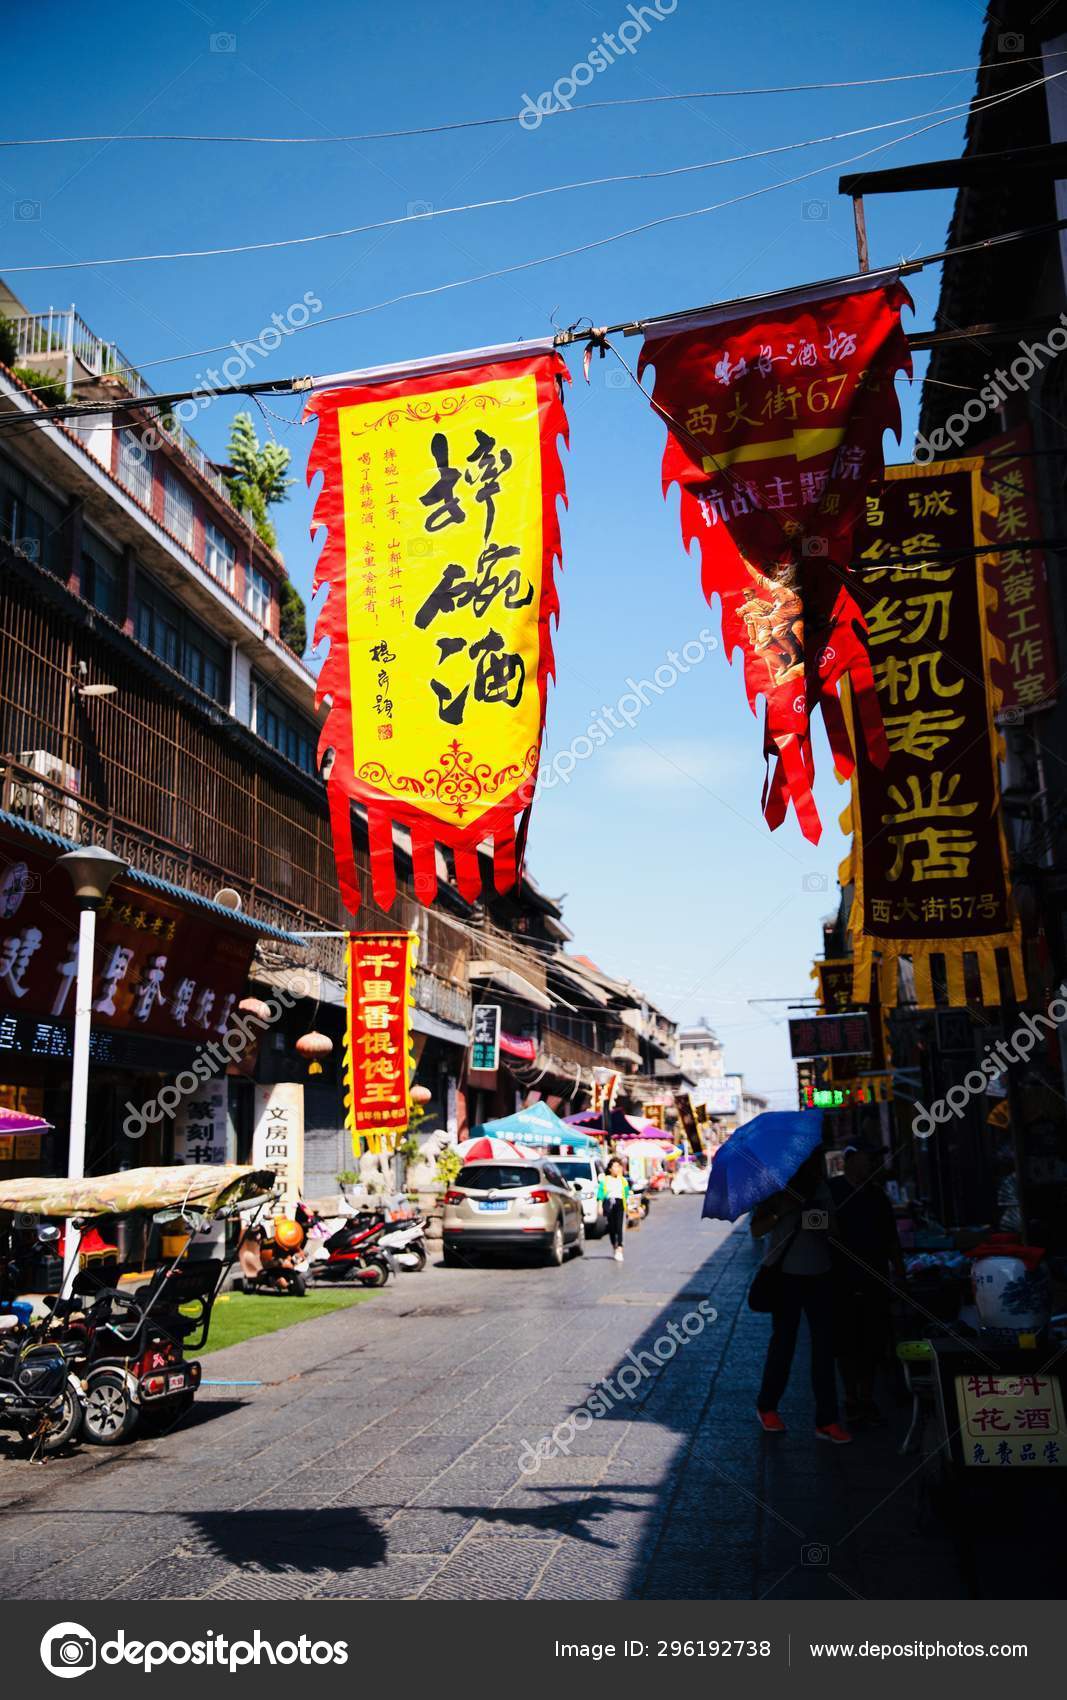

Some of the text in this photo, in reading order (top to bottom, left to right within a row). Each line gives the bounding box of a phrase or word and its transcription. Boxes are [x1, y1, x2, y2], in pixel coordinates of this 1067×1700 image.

[714, 328, 858, 387] 牡丹酒坊
[414, 429, 534, 725] 摔碗酒
[860, 531, 979, 883] 缝纫机专业店
[870, 893, 999, 924] 西大街57号
[357, 953, 401, 1104] 千里香馄饨王
[967, 1375, 1048, 1398] 牡丹
[972, 1408, 1051, 1432] 花酒
[973, 1441, 1061, 1465] 免费品尝
